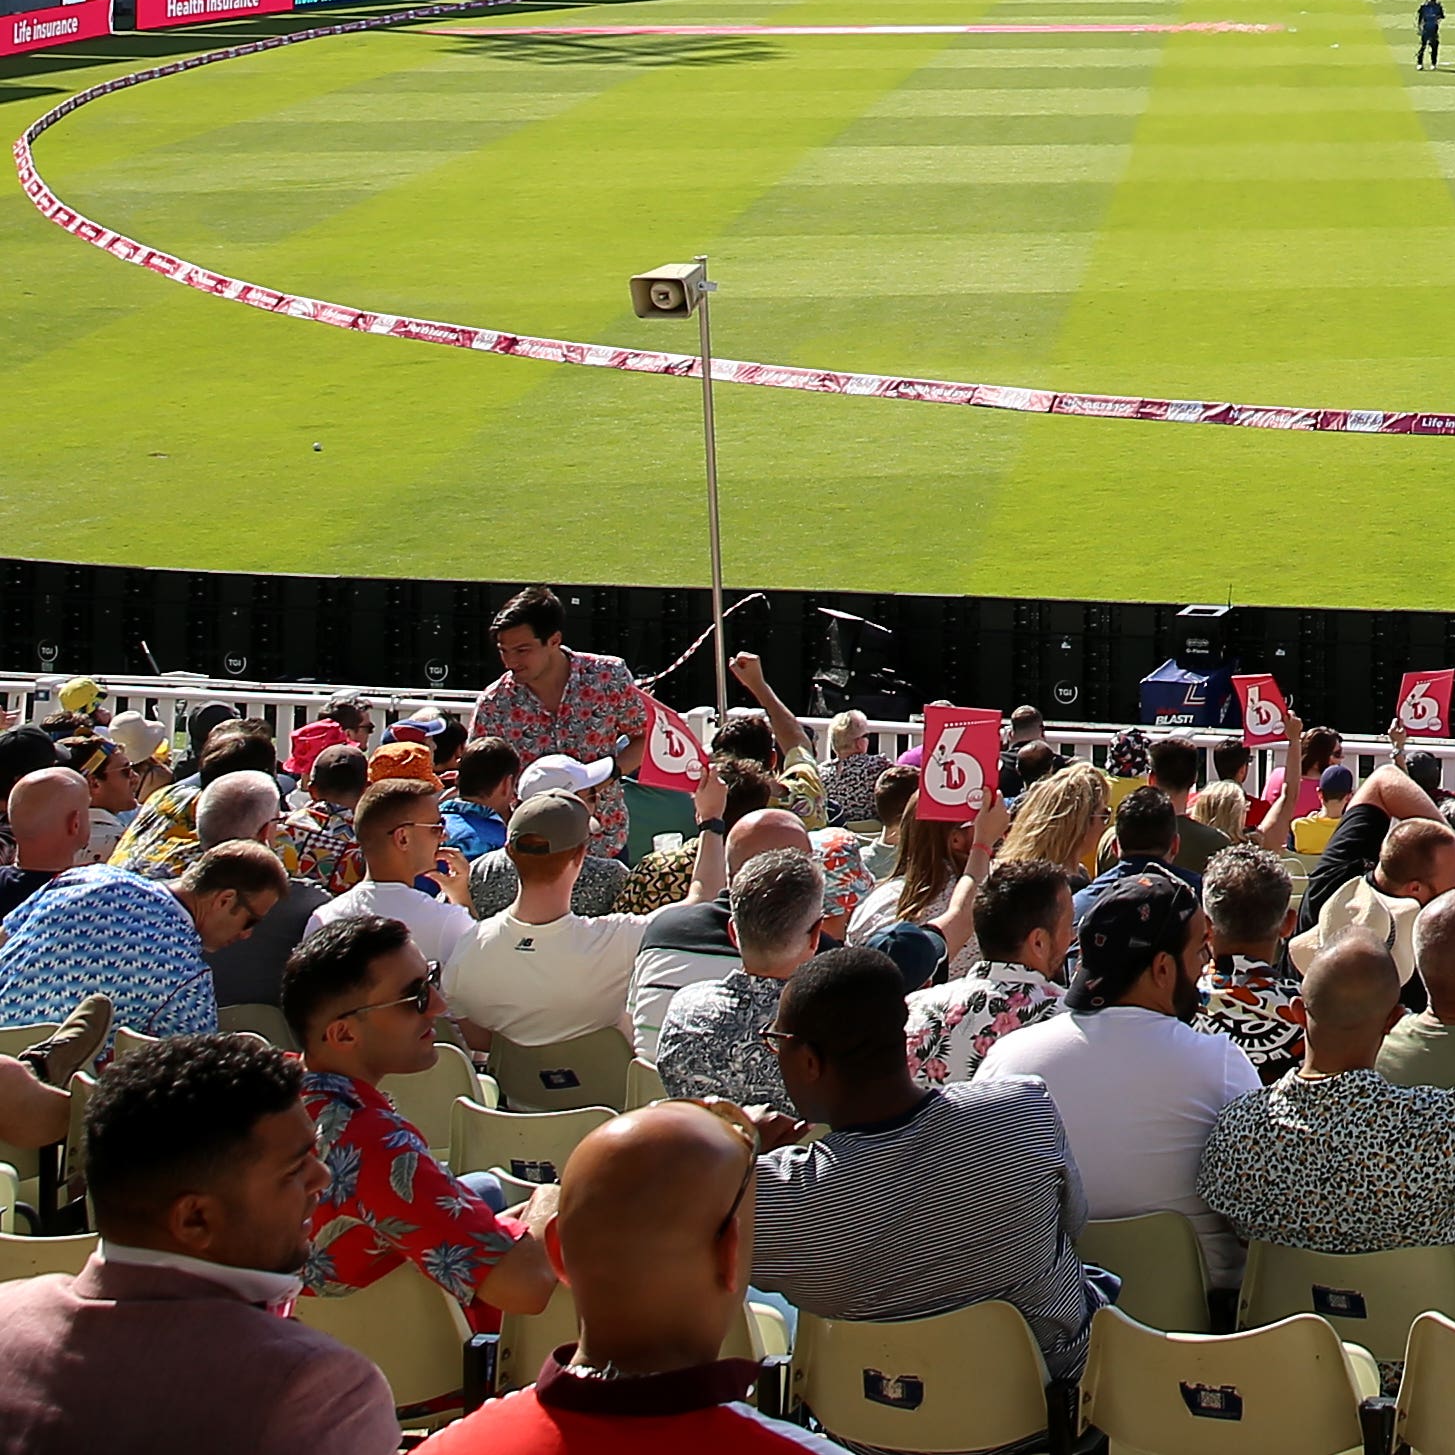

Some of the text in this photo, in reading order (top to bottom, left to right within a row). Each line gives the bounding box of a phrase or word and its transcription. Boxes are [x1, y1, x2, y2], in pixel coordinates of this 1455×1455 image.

[13, 16, 79, 45] Life insurance
[1421, 417, 1443, 430] Life
[1058, 688, 1072, 696] TGI
[1155, 713, 1194, 727] BLAST!
[1399, 681, 1441, 733] 6
[651, 704, 699, 774] 6
[924, 726, 984, 806] 6
